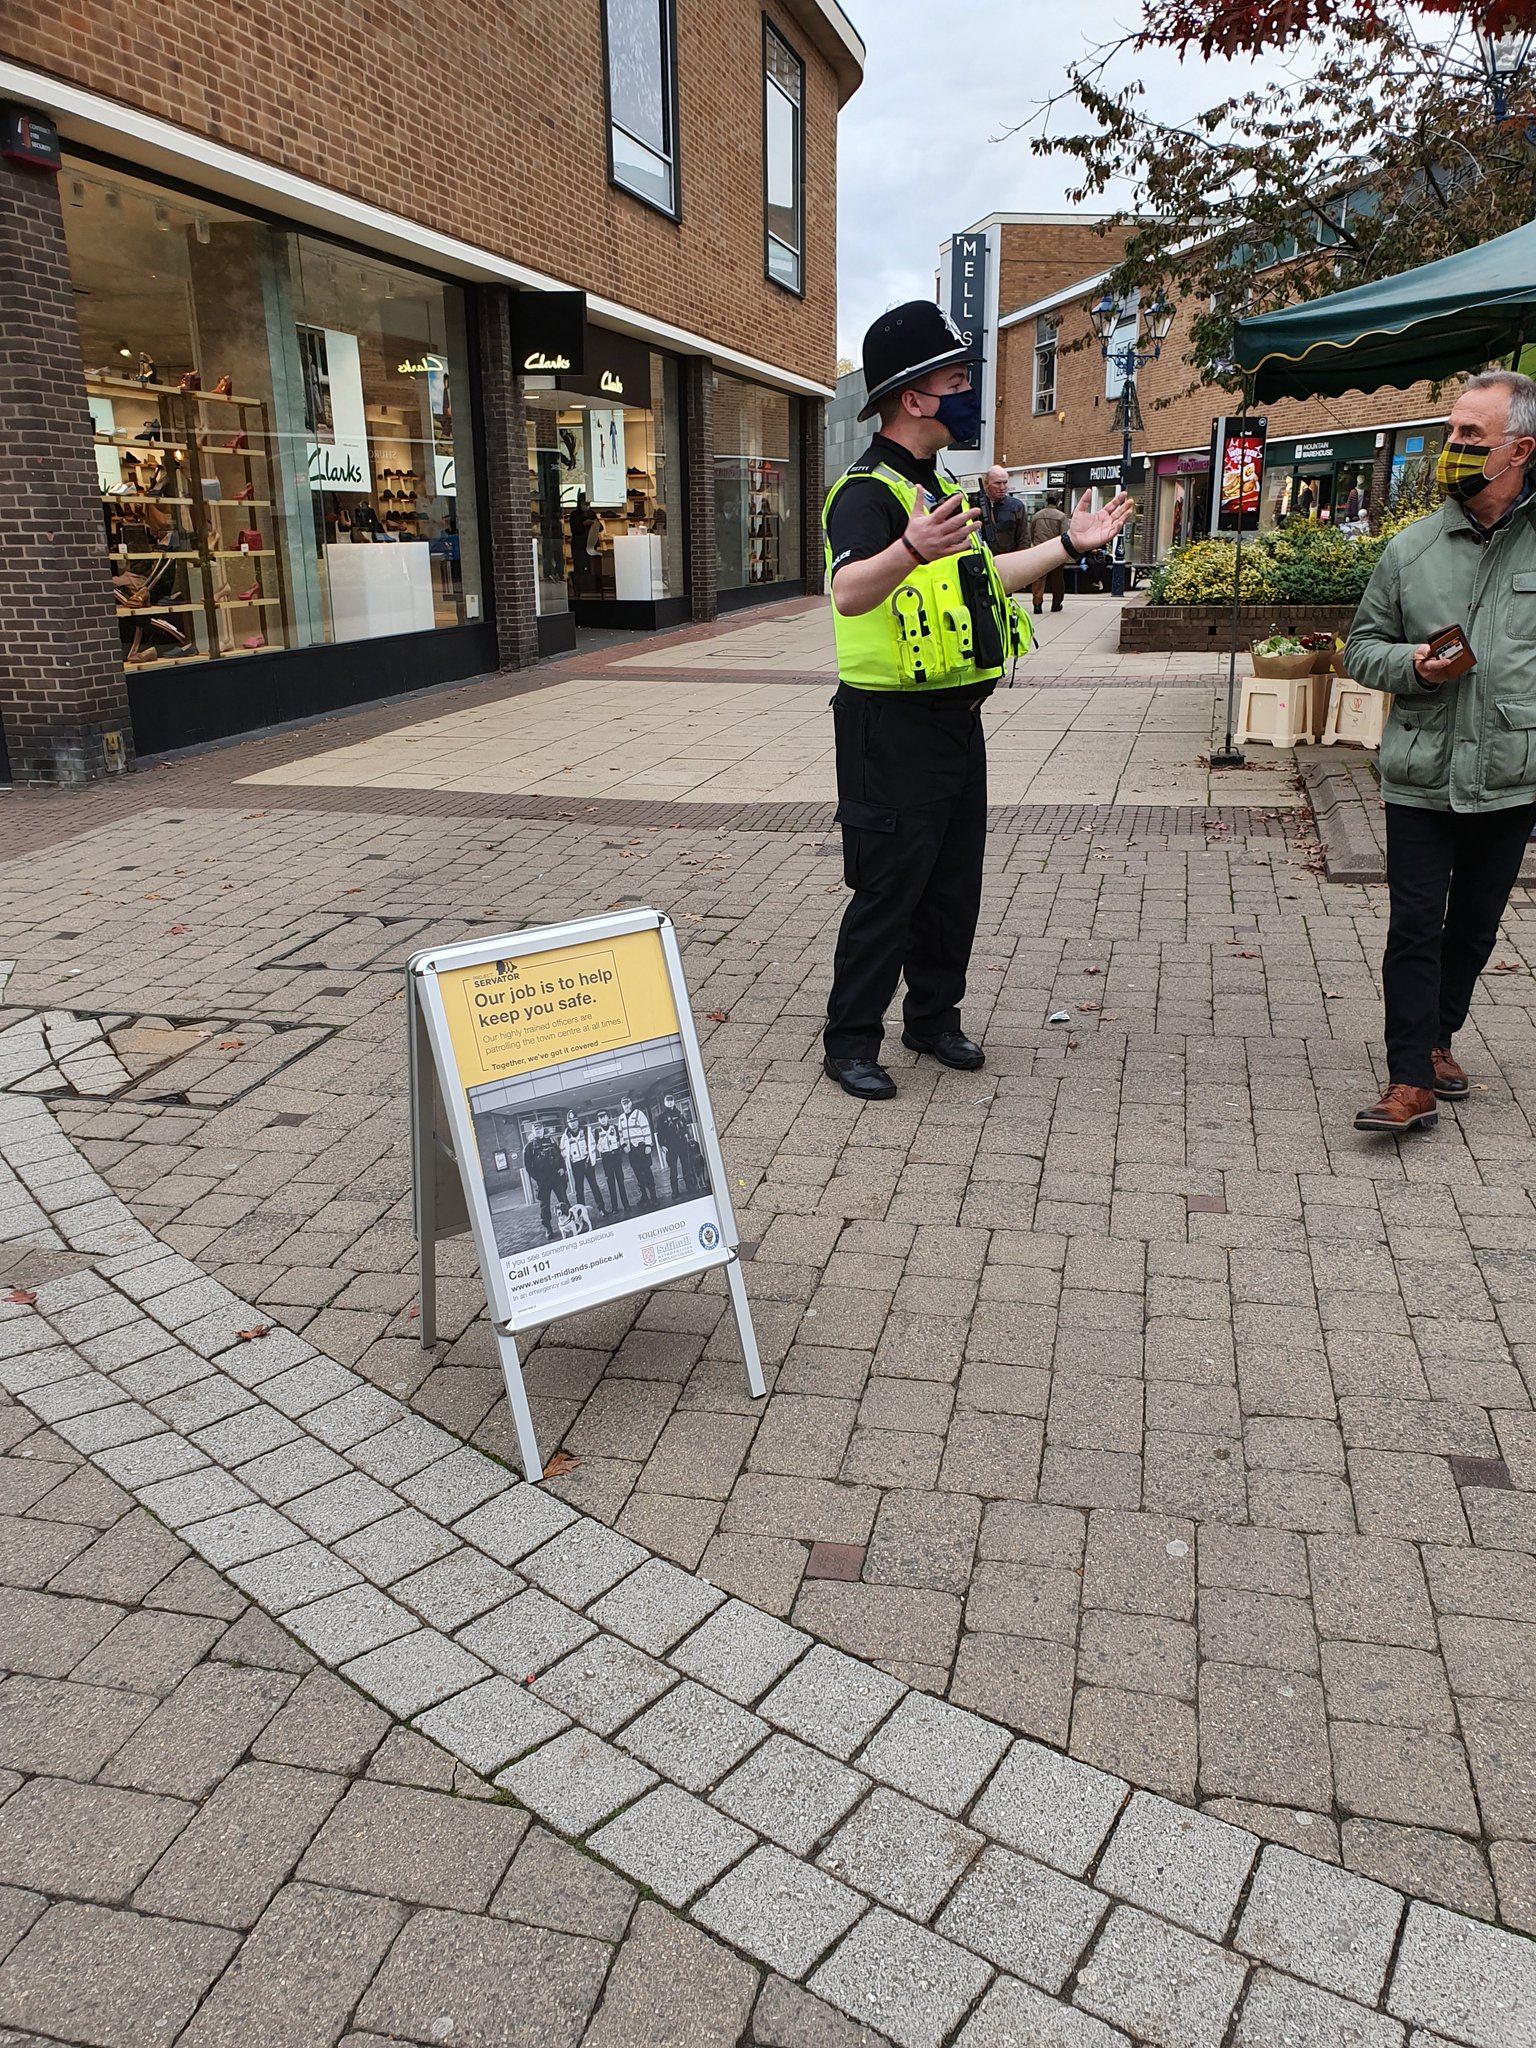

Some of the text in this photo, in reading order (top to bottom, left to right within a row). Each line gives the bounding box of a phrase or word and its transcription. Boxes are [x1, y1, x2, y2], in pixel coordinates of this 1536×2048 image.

[524, 352, 570, 370] Clarks
[1302, 449, 1334, 458] WAREHOUSE
[1303, 442, 1330, 450] MOUNTAIN
[308, 447, 362, 483] Clarks
[1023, 470, 1041, 487] FONE
[1090, 465, 1121, 481] PHOTO ZONE
[474, 972, 520, 988] SERVATOR
[474, 969, 613, 1008] Our job is to help
[478, 992, 597, 1028] keep you safe.
[483, 1013, 593, 1044] Our highly trained officers are
[485, 1018, 624, 1056] patrolling the town centre at all times.
[492, 1040, 599, 1071] Together, we've got it covered
[638, 1220, 686, 1241] TOUCHWOOD
[505, 1230, 615, 1269] If you see something suspicious
[508, 1260, 552, 1281] Call 101
[511, 1251, 624, 1293] www.west-midlands.police.uk
[512, 1274, 583, 1302] In an emergency call 999
